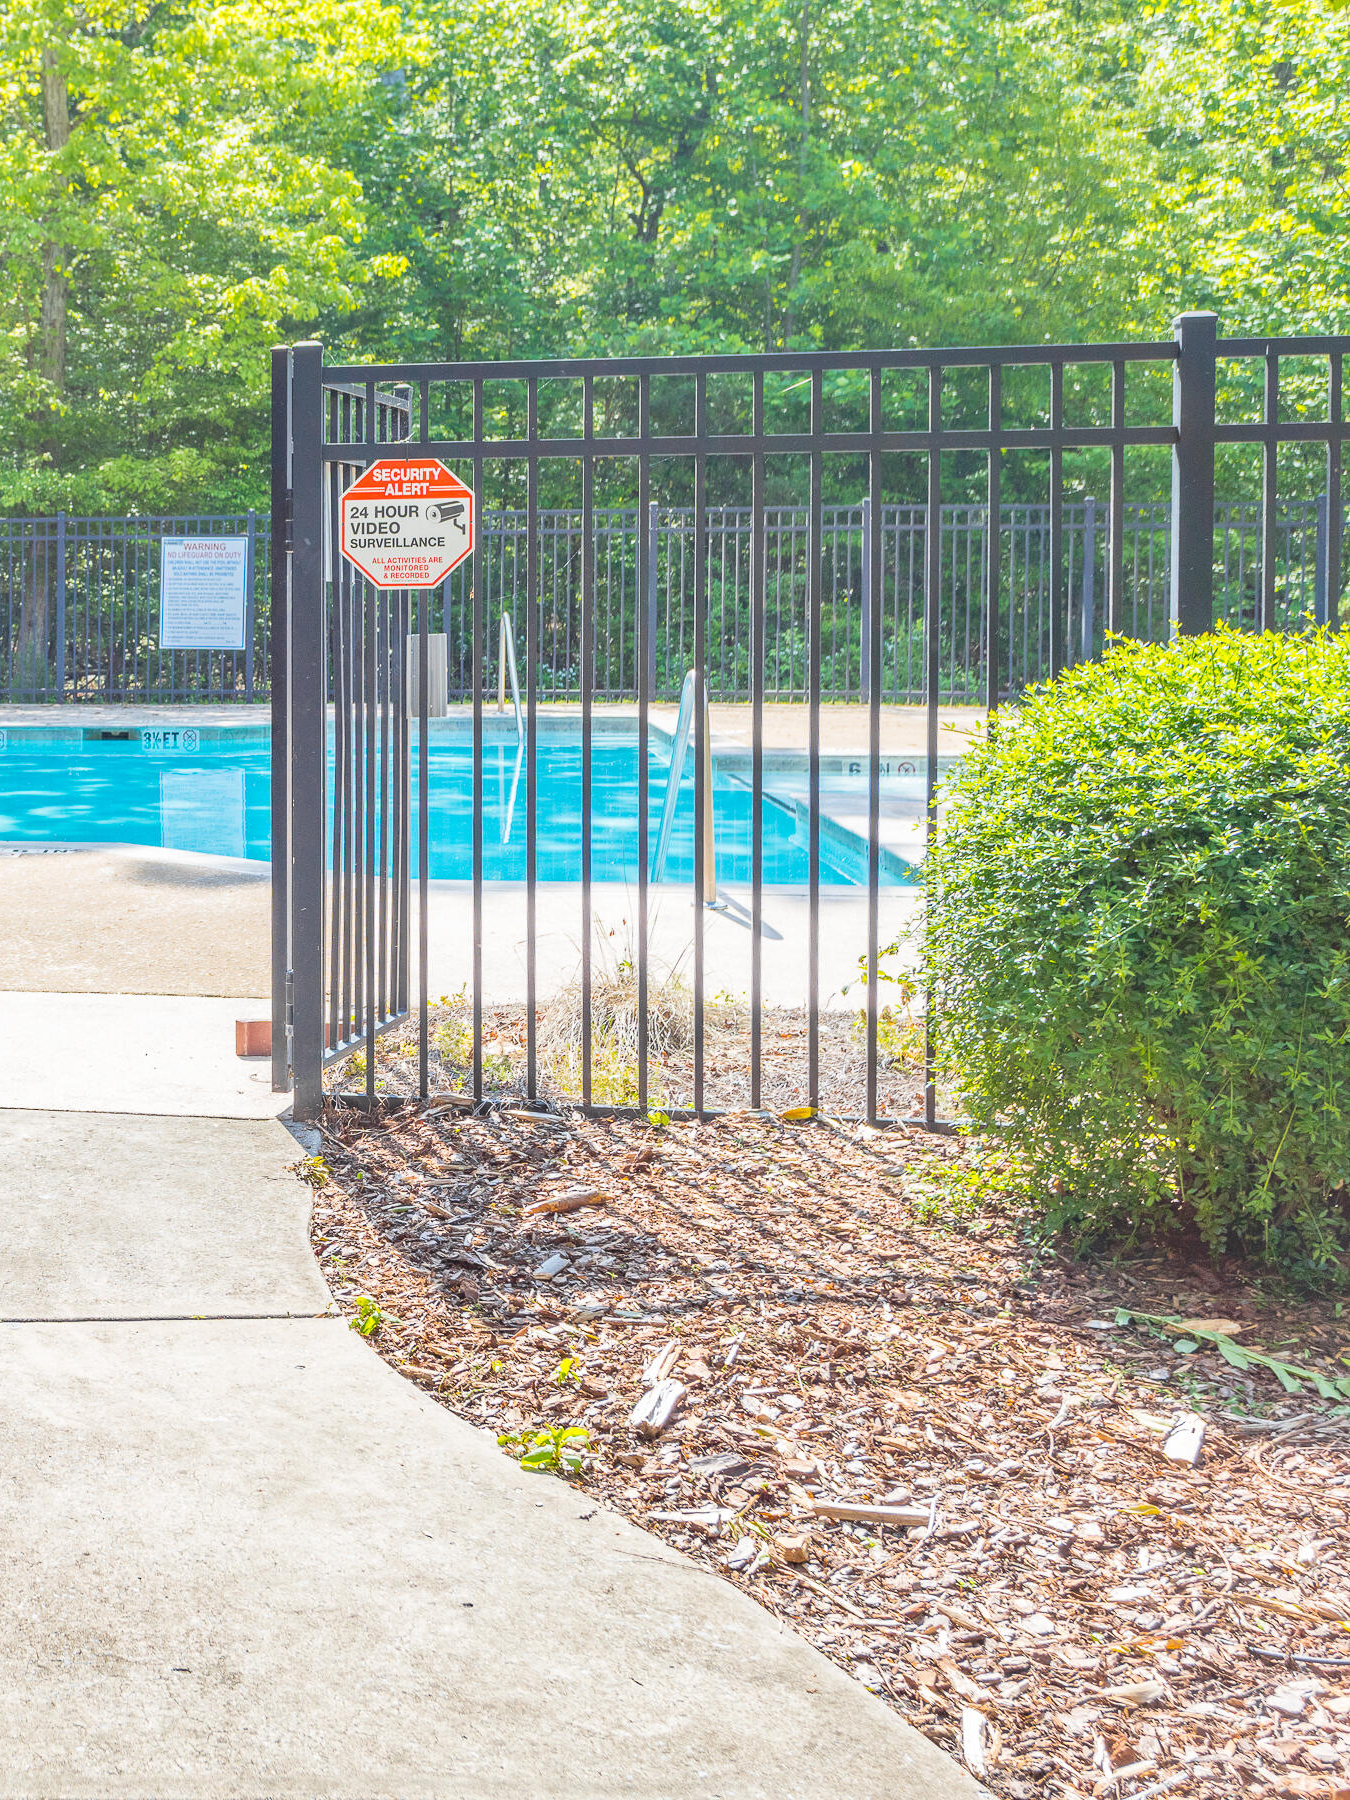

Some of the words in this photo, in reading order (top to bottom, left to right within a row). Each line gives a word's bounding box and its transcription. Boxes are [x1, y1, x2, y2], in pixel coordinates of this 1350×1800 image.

[372, 467, 442, 481] SECURITY
[385, 482, 430, 496] ALERT
[350, 506, 369, 519] 24
[374, 505, 419, 518] HOUR
[350, 522, 401, 535] VIDEO
[183, 542, 227, 551] WARNING
[350, 537, 446, 549] SURVEILLANCE
[167, 551, 177, 559] NO
[178, 551, 213, 559] LIFEGUARD
[214, 551, 224, 559] ON
[225, 551, 242, 559] DUTY
[387, 556, 427, 564] ACTIVITIES
